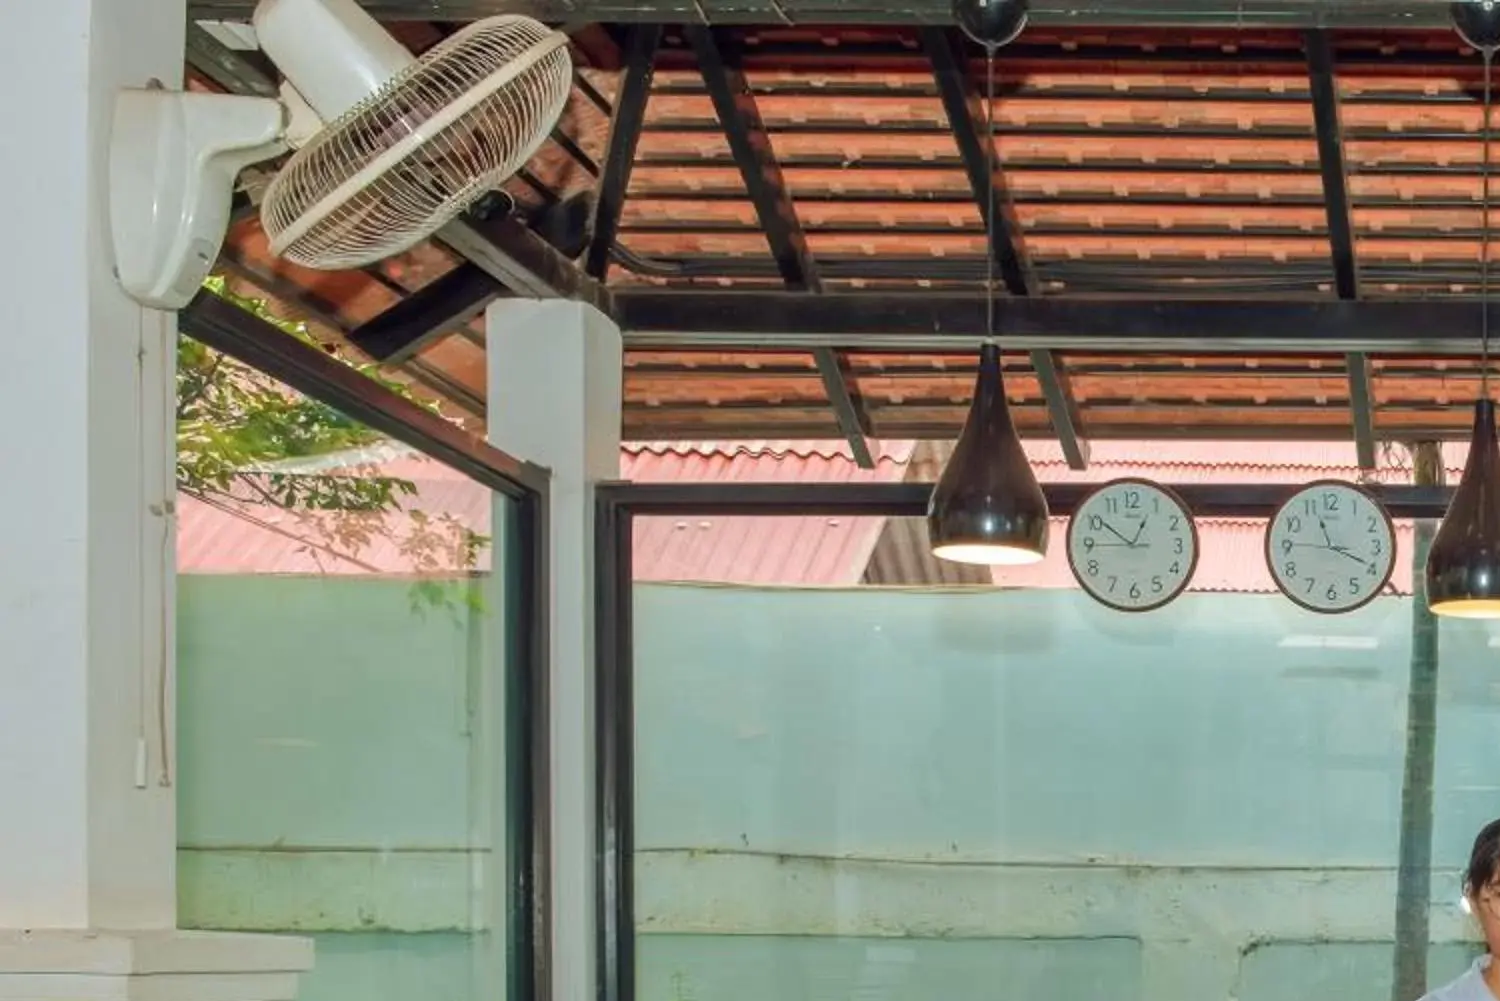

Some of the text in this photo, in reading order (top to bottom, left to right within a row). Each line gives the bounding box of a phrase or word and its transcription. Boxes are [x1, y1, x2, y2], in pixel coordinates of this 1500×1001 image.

[1105, 497, 1118, 514] 11
[1124, 491, 1141, 509] 12
[1152, 497, 1159, 513] 1
[1304, 499, 1317, 516] 11
[1322, 493, 1339, 511] 12
[1352, 499, 1358, 516] 1
[1087, 513, 1103, 531] 10
[1169, 515, 1180, 531] 2
[1286, 515, 1301, 533] 10
[1367, 516, 1378, 533] 2
[1083, 537, 1095, 555] 9
[1173, 537, 1183, 555] 3
[1281, 539, 1293, 555] 9
[1371, 539, 1382, 556] 3
[1087, 559, 1099, 577] 8
[1168, 561, 1180, 574] 4
[1285, 561, 1297, 578] 8
[1366, 562, 1377, 576] 4
[1107, 575, 1118, 593] 7
[1129, 582, 1142, 599] 6
[1151, 575, 1164, 593] 5
[1305, 577, 1315, 593] 7
[1326, 584, 1337, 601] 6
[1349, 577, 1360, 595] 5
